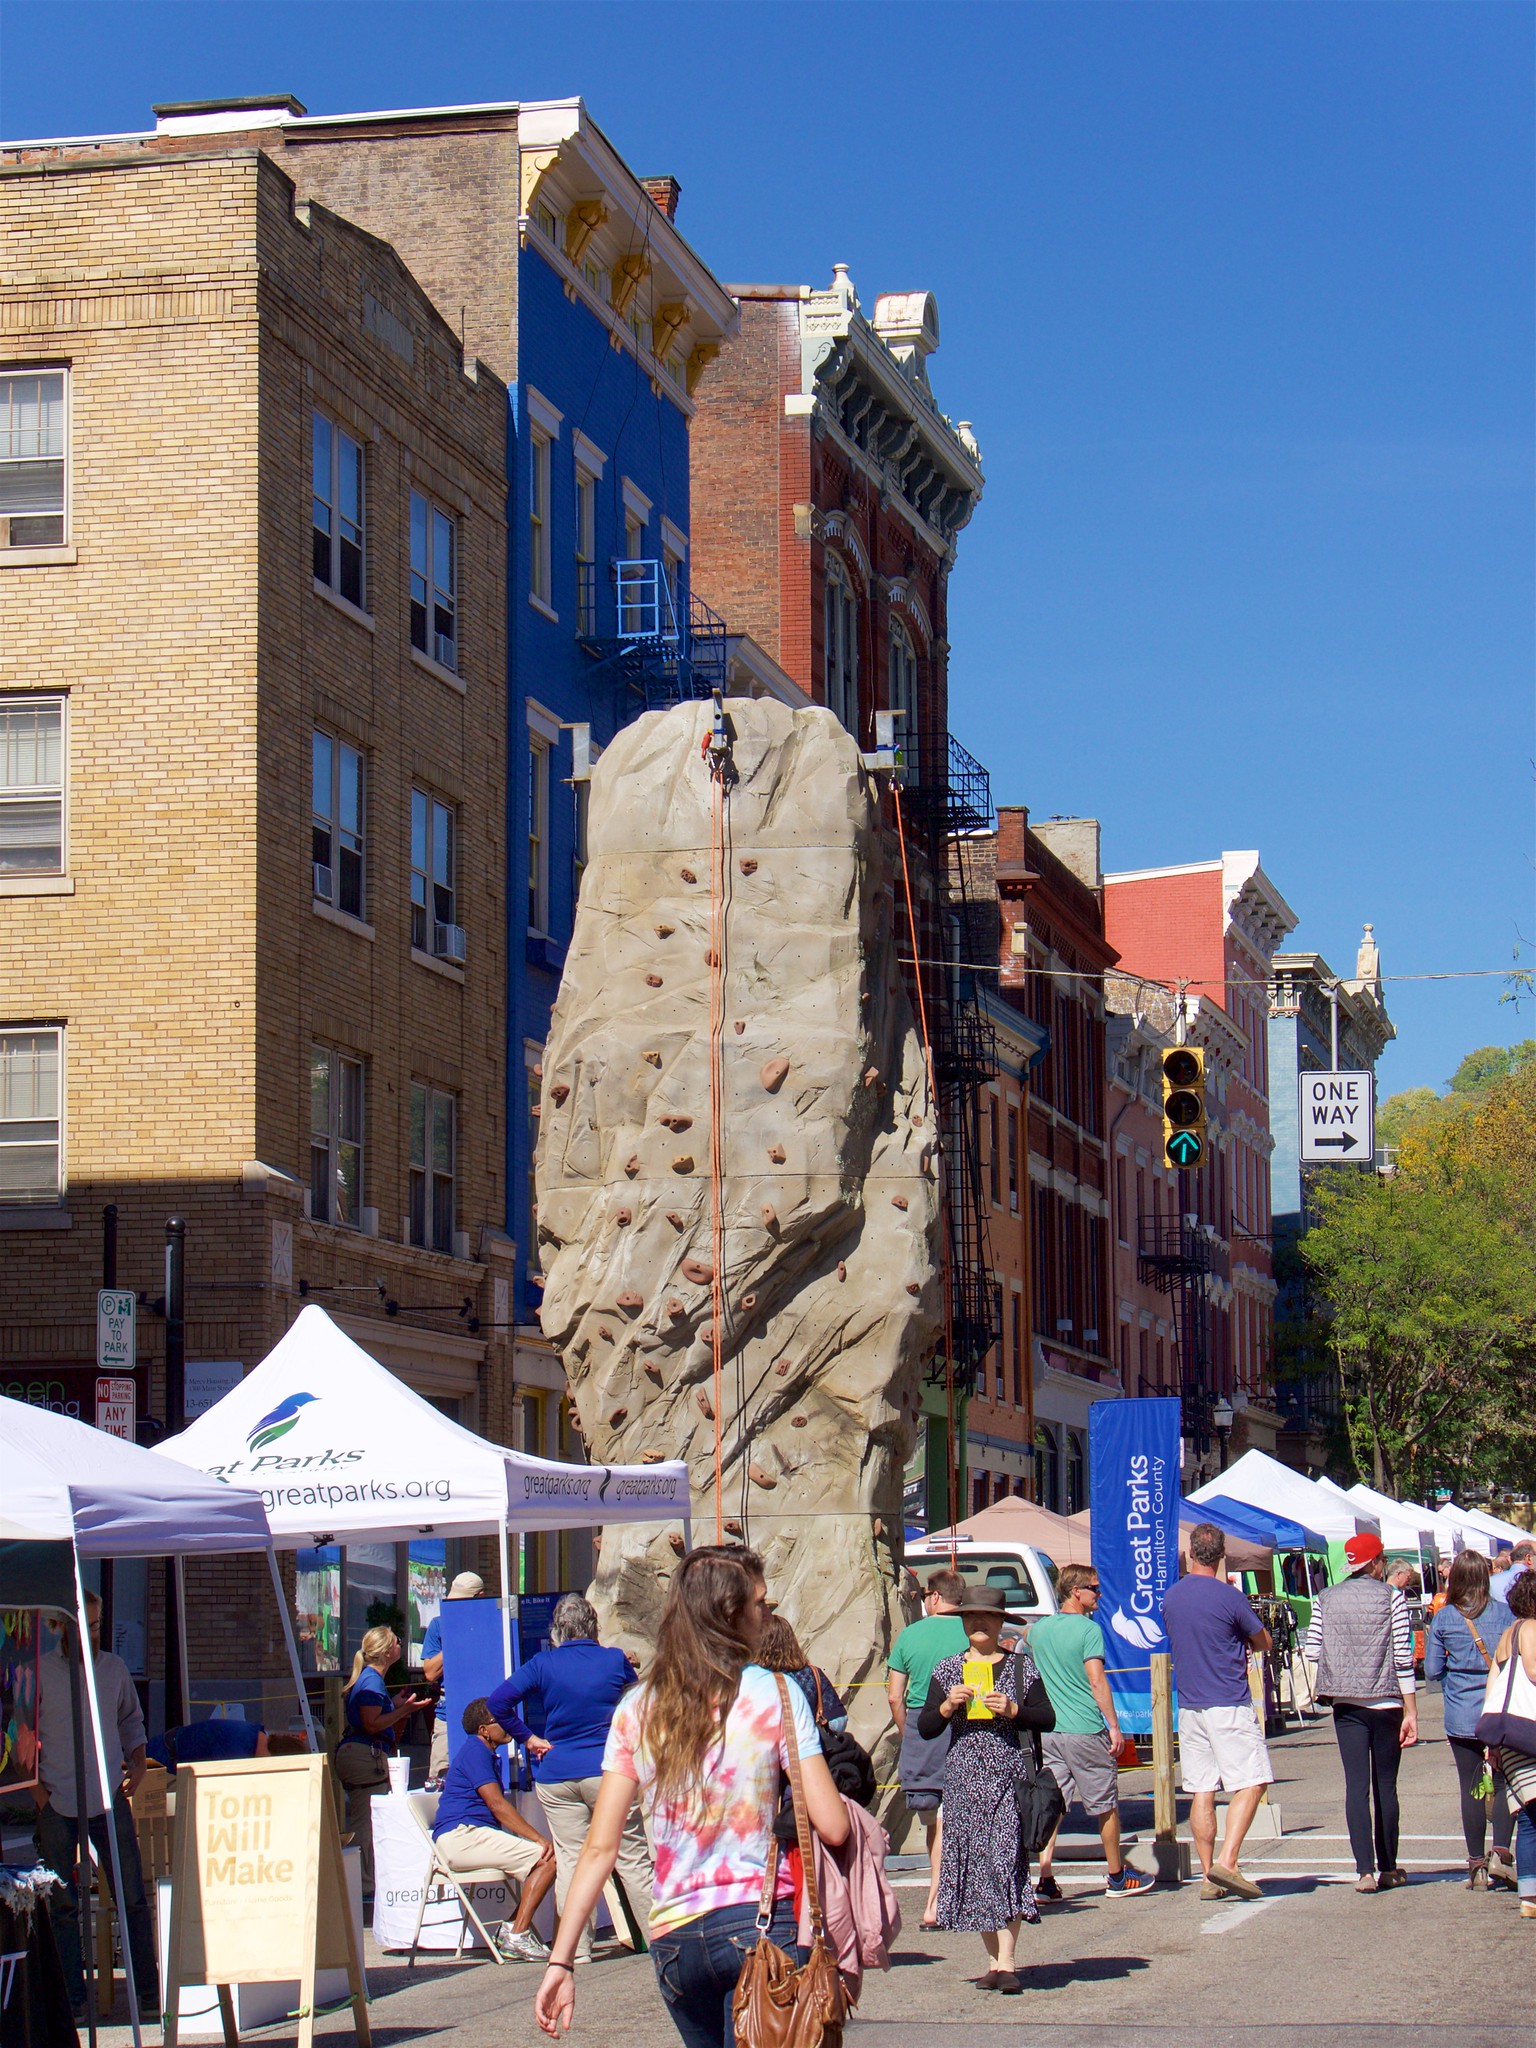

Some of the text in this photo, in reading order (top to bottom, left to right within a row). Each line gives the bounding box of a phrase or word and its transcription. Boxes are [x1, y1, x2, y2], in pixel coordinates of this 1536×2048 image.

[1313, 1082, 1359, 1101] ONE
[1312, 1105, 1359, 1125] WAY
[108, 1317, 125, 1329] PAY
[111, 1329, 122, 1341] TO
[104, 1341, 128, 1353] PARK
[98, 1383, 109, 1398] NO
[111, 1383, 132, 1392] STOPPING
[112, 1392, 131, 1400] PARKING
[105, 1407, 126, 1421] ANY
[104, 1425, 127, 1438] TIME
[250, 1449, 366, 1472] Parks
[260, 1479, 451, 1514] greatparks.org
[524, 1473, 592, 1500] greatparks.org
[616, 1475, 677, 1501] greatparks.org
[1126, 1454, 1154, 1614] Great Parks
[1152, 1455, 1167, 1612] of Hamilton County
[204, 1790, 272, 1820] Tom
[207, 1820, 271, 1853] Will
[206, 1854, 294, 1887] Make
